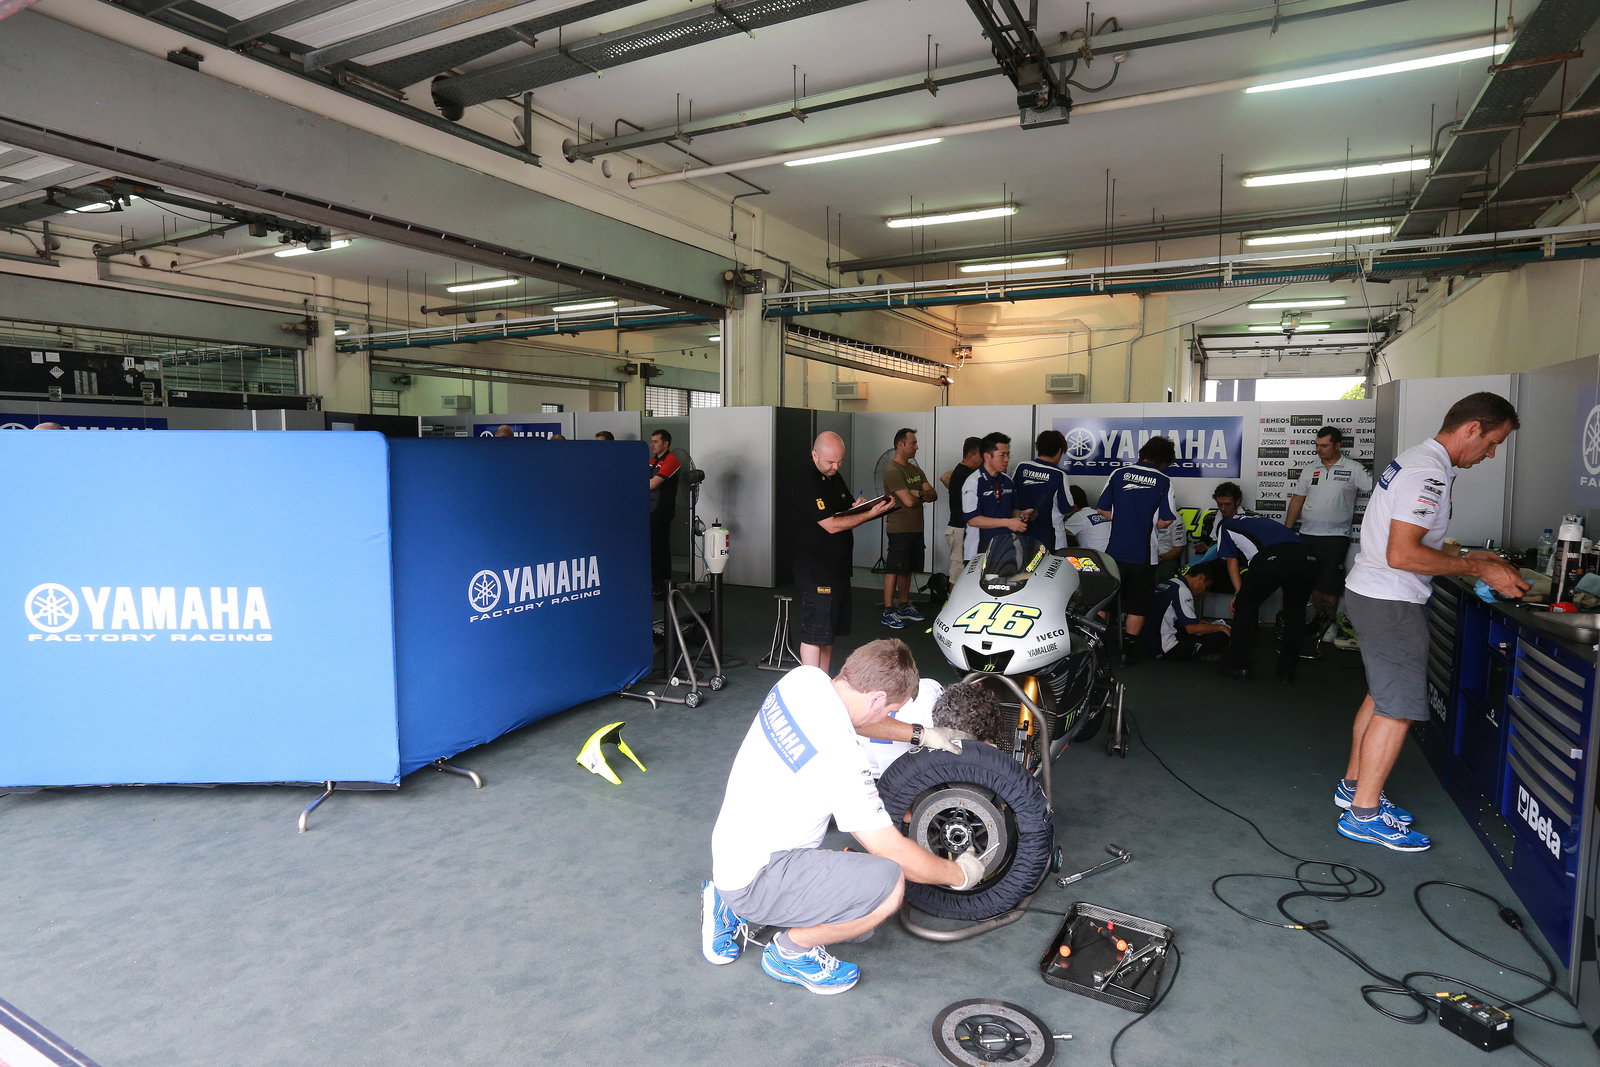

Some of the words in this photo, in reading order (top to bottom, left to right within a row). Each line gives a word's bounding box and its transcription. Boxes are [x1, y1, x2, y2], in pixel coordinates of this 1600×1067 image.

[1028, 470, 1050, 480] YAMAHA
[1063, 460, 1133, 468] FACTOR
[1131, 473, 1157, 485] YAMAHA
[503, 555, 601, 604] YAMAHA
[1044, 558, 1064, 579] YAMAHA
[80, 586, 272, 630] YAMAHA
[469, 601, 544, 623] FACTORY
[551, 589, 601, 605] RACING
[952, 601, 1042, 639] 46
[28, 633, 157, 642] FACTORY
[170, 633, 273, 642] RACING
[1035, 628, 1065, 643] IVECO
[1027, 643, 1058, 658] YAMALUBE
[1432, 688, 1447, 723] Beta
[766, 701, 807, 762] YAMAHA
[1528, 796, 1562, 860] Beta
